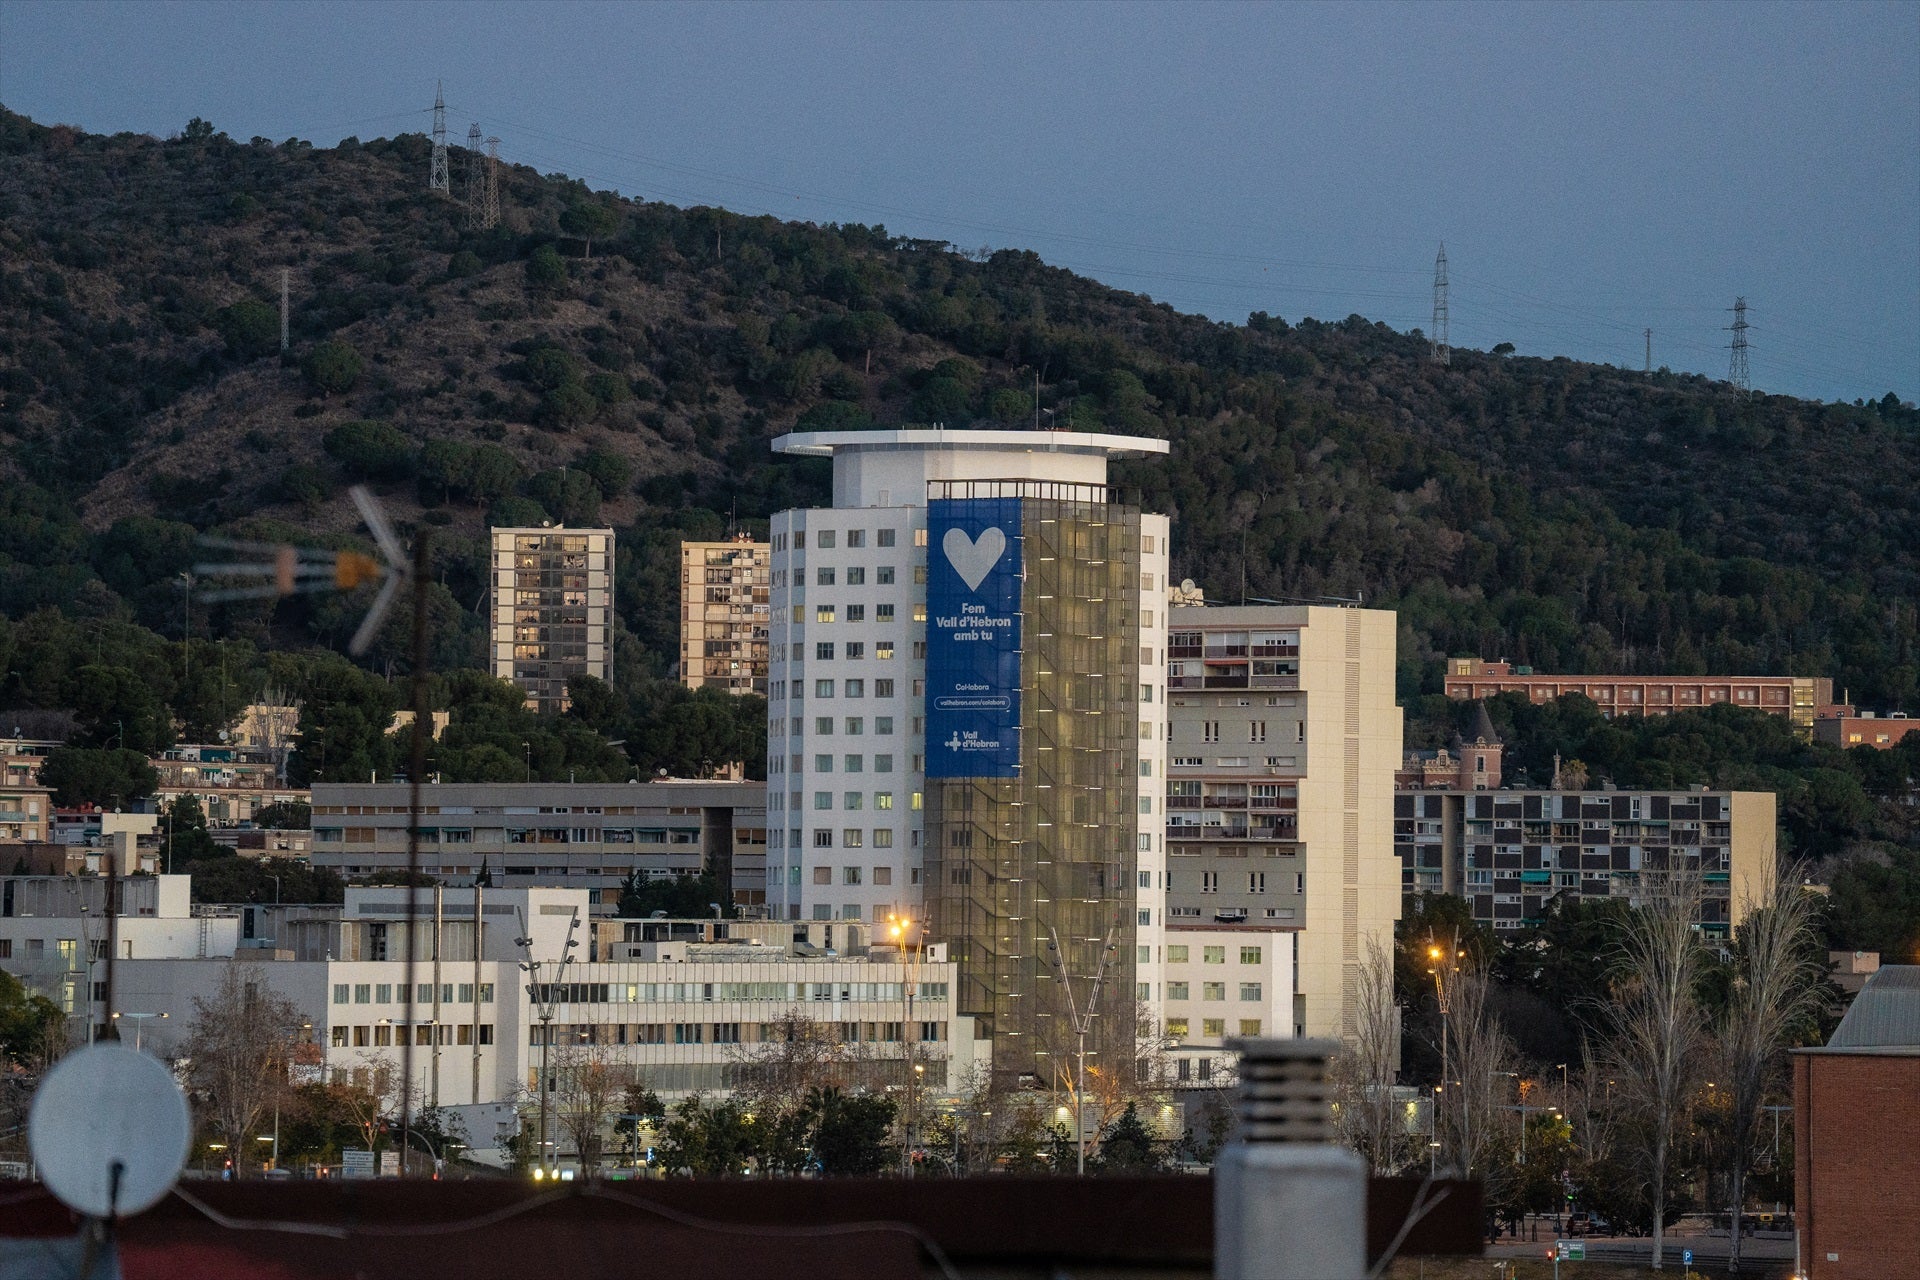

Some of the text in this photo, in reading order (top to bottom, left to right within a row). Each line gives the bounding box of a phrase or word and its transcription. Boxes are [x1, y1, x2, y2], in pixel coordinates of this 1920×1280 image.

[962, 603, 985, 613] Fem
[936, 616, 1011, 627] Vall d'Hebron
[954, 630, 993, 640] amb tu
[962, 731, 978, 739] Vall
[962, 740, 999, 748] d'Hebron
[1685, 1251, 1691, 1261] P
